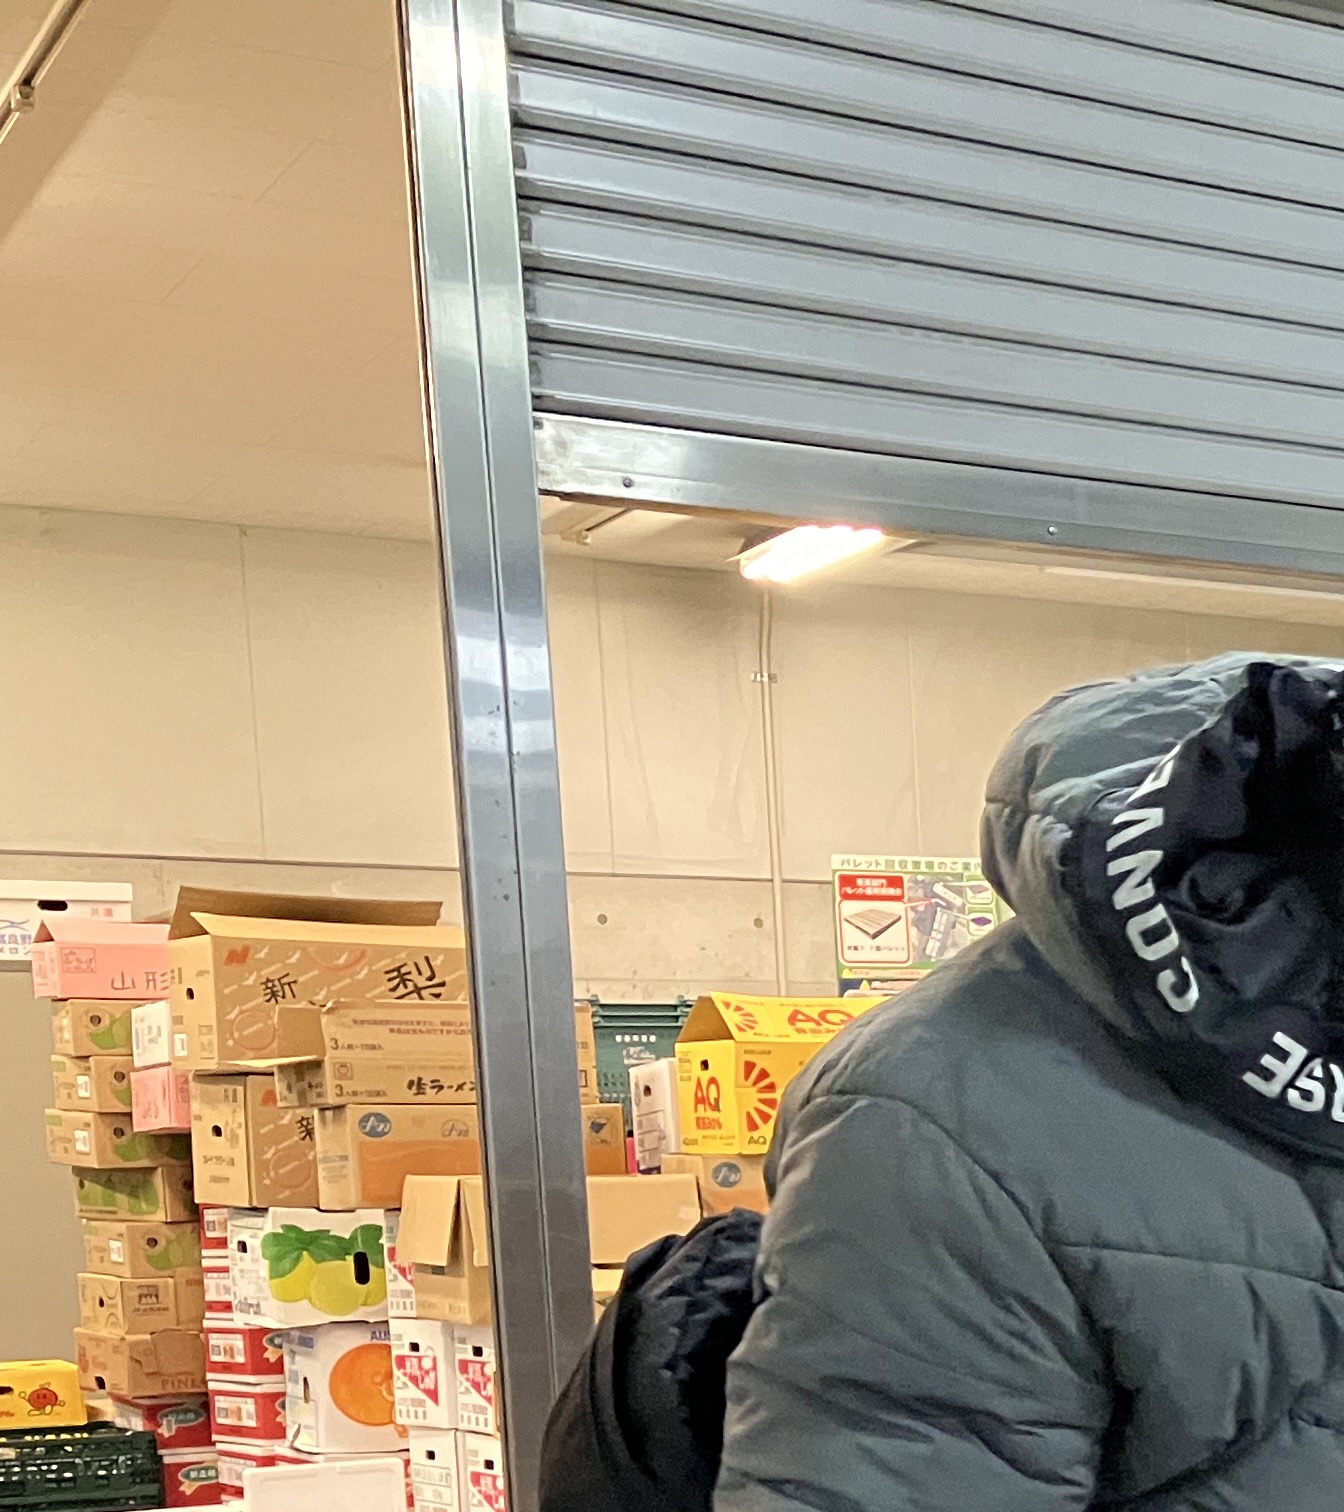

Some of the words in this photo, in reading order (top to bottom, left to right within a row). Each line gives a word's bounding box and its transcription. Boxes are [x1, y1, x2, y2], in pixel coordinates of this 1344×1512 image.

[383, 955, 446, 1000] 梨
[788, 1009, 860, 1027] AQ
[693, 1076, 722, 1114] AQ
[747, 1135, 768, 1146] AQ
